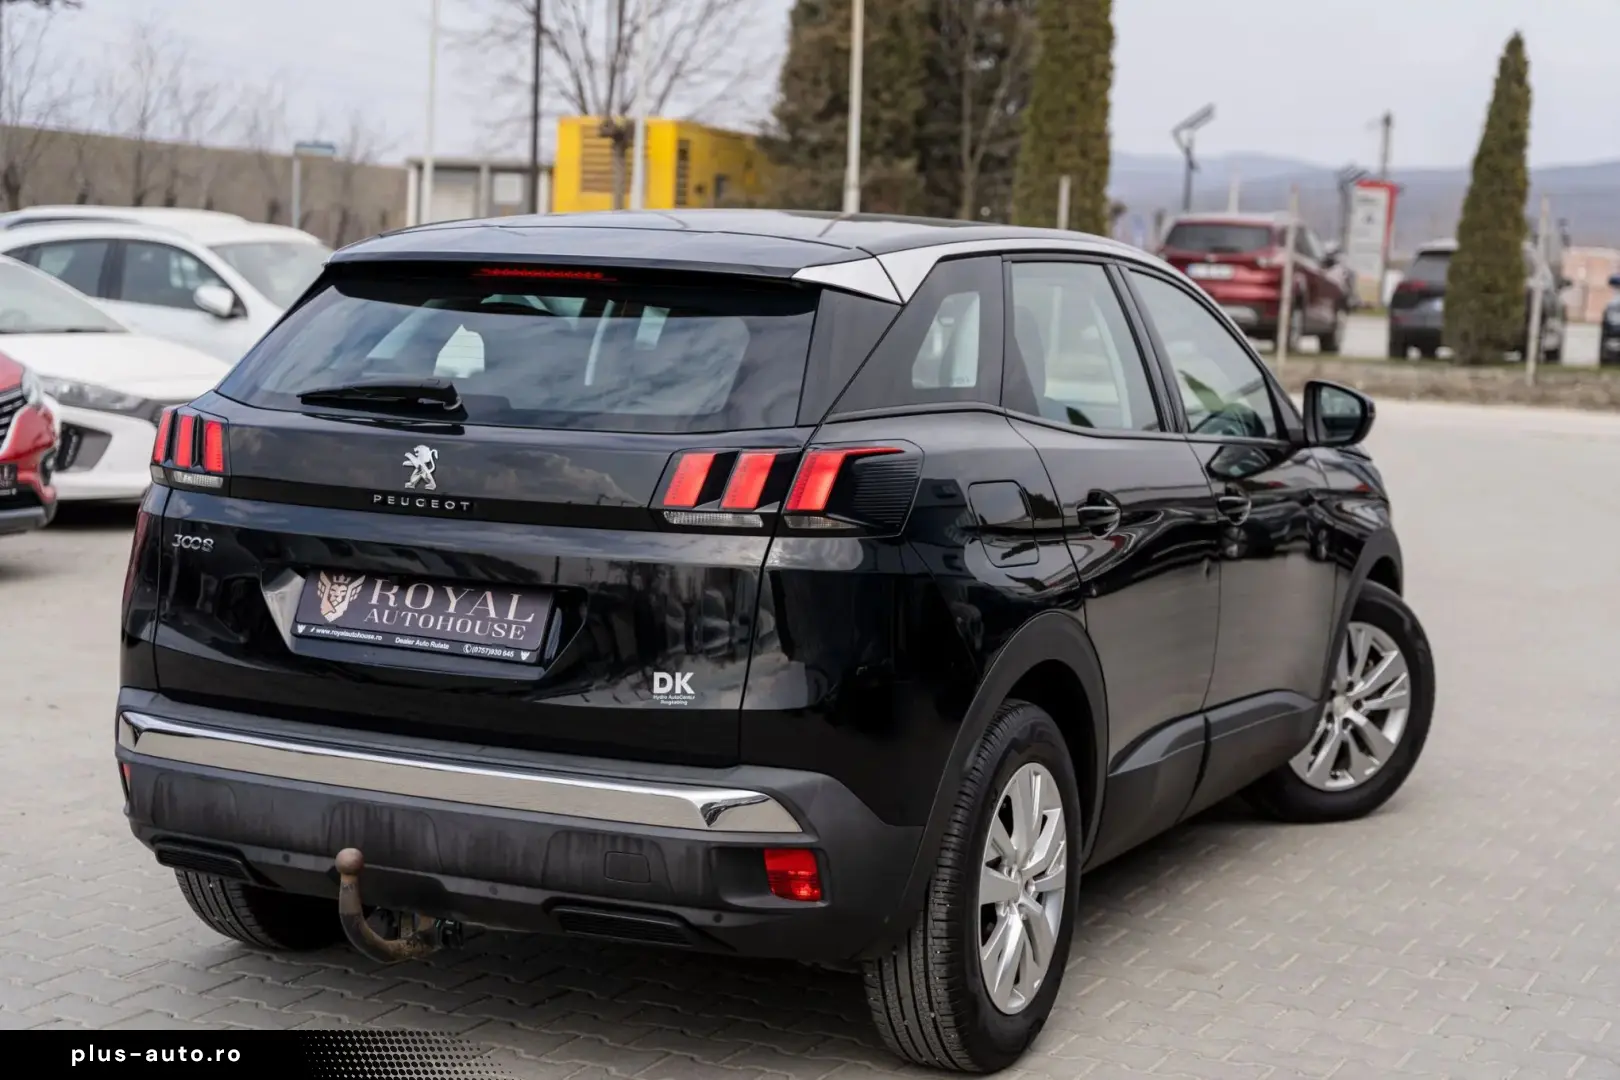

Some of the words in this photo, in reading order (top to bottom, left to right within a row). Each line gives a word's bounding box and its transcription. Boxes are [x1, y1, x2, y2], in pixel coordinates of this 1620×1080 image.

[373, 494, 470, 511] PEUGEOT
[171, 533, 214, 553] 3008
[367, 578, 535, 623] ROYAL
[363, 608, 526, 641] AUTOHOUSE
[395, 636, 414, 646] Dealer
[415, 638, 429, 647] Auto
[653, 671, 695, 694] DK
